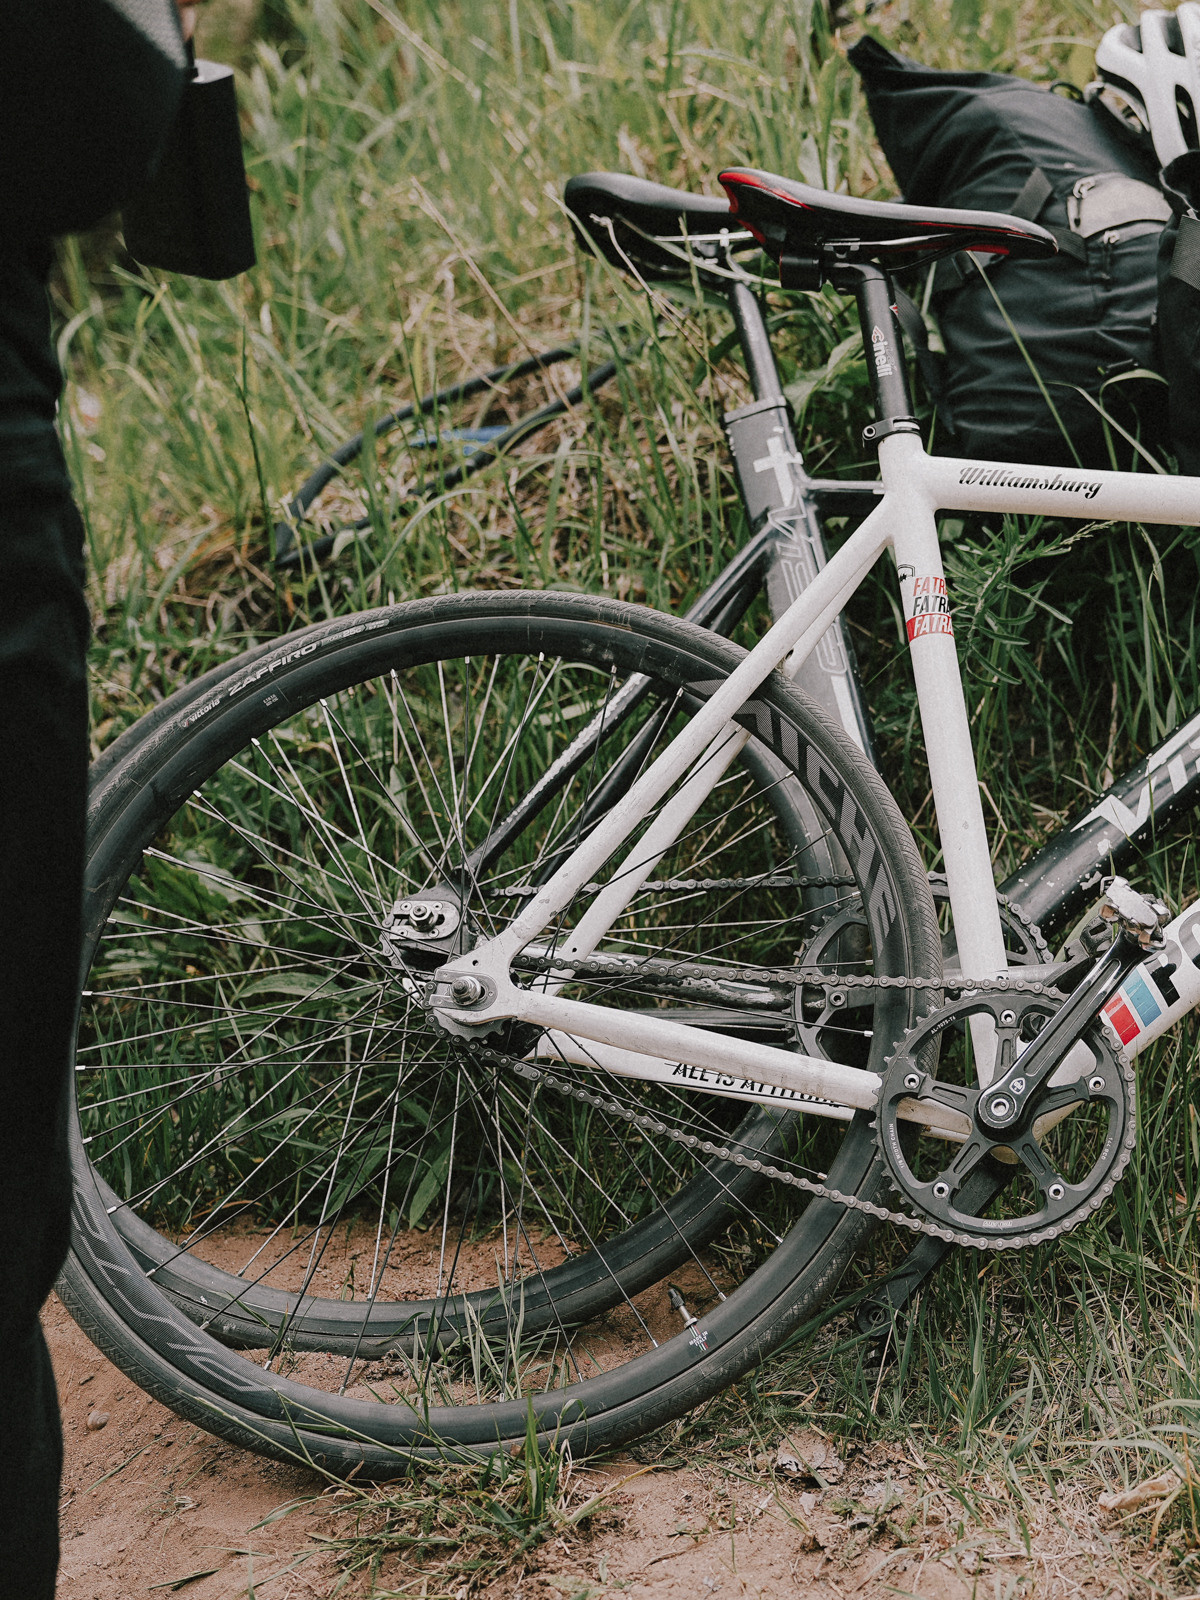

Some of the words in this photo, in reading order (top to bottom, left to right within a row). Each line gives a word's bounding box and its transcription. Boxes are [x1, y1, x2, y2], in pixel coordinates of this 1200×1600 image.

[959, 467, 1104, 500] Williamsburg
[228, 643, 317, 696] ZAFFIRO
[672, 1063, 709, 1082] ALL
[888, 1123, 896, 1141] CHAIN
